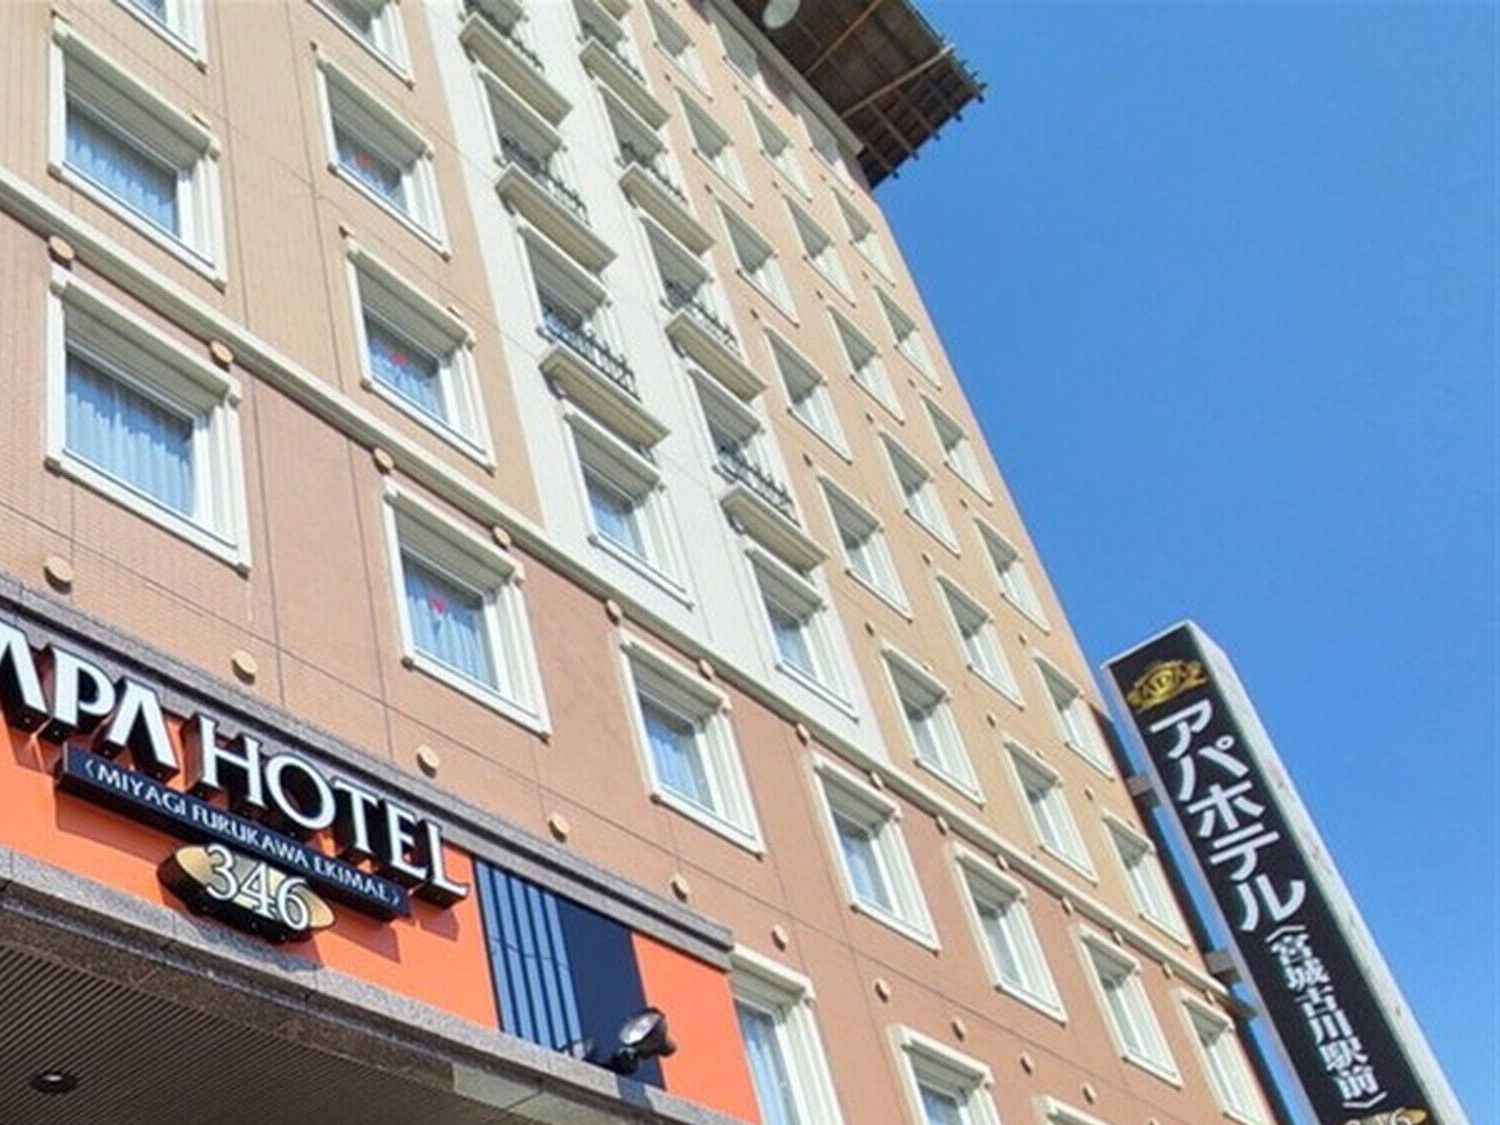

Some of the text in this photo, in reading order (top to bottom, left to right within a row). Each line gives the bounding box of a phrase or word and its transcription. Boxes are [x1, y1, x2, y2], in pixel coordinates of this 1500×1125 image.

[191, 804, 309, 869] FURUKAWA
[199, 714, 469, 898] HOTEL
[1149, 698, 1305, 932] アパホテル
[205, 843, 311, 931] 346
